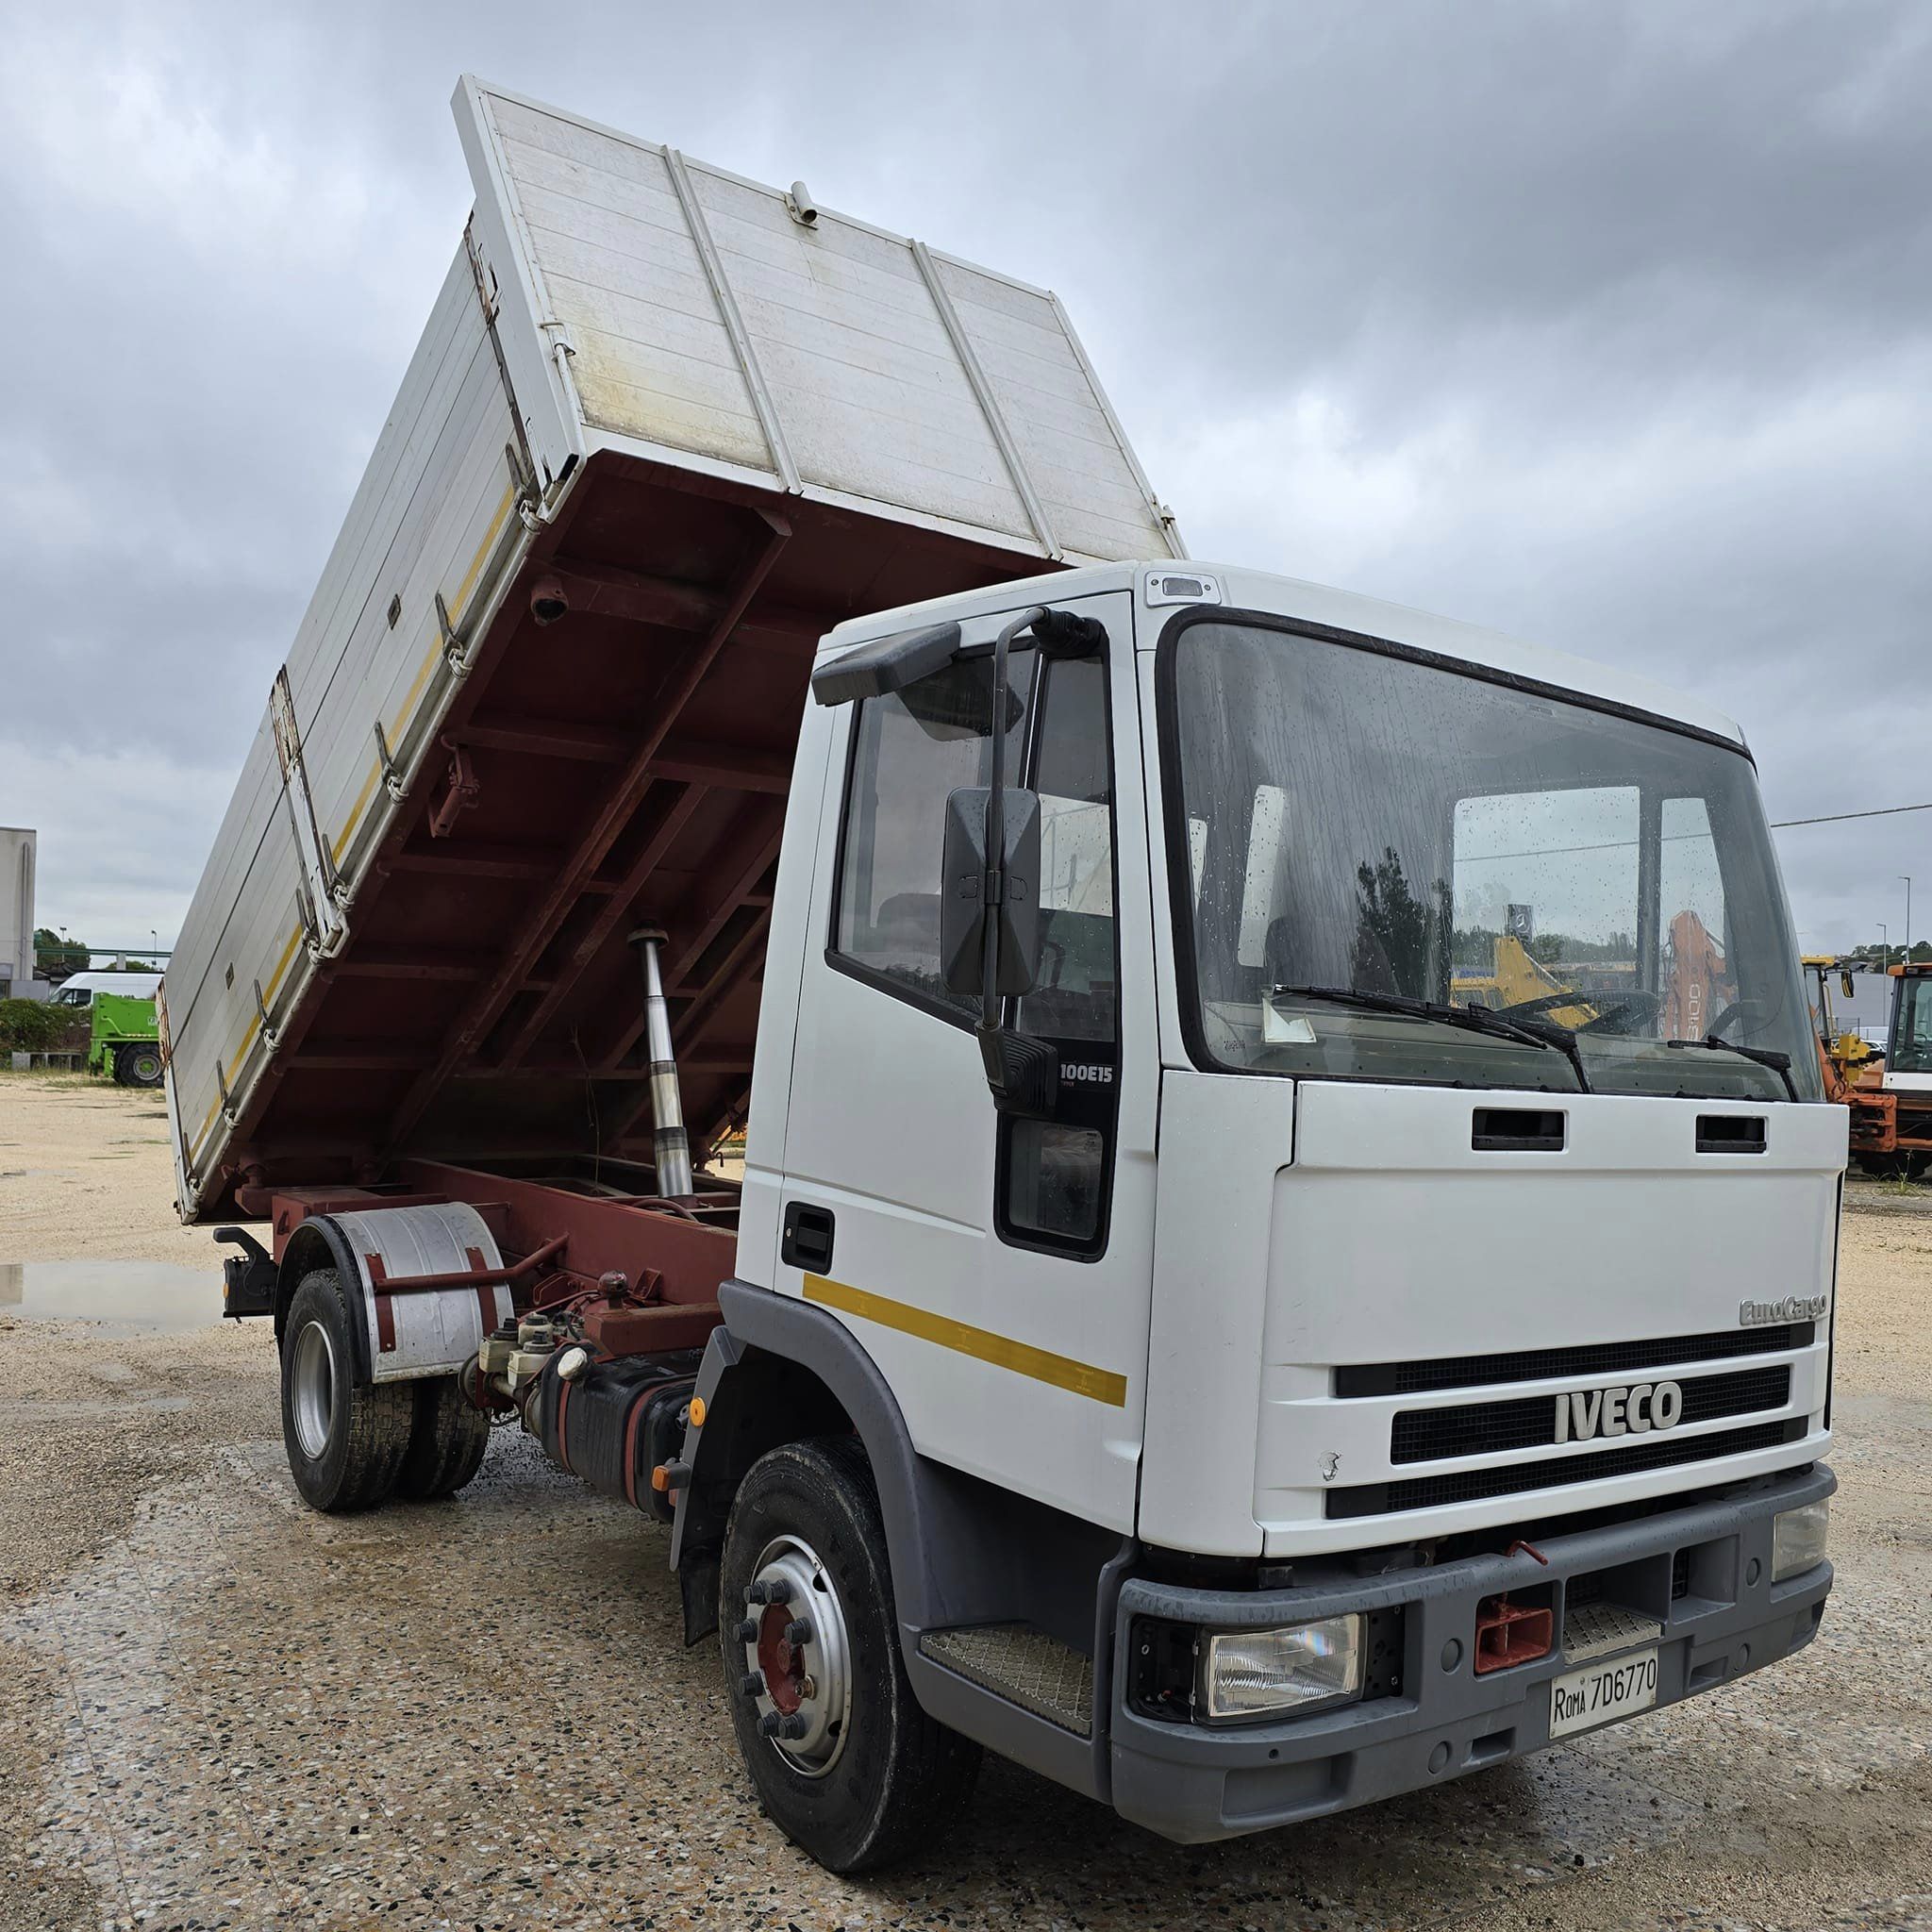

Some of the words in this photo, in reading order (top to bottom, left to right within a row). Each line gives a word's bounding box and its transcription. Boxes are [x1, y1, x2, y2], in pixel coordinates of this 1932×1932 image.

[1060, 1063, 1113, 1083] 100E15
[1740, 1294, 1826, 1325] EuroCargo
[1554, 1381, 1683, 1443] IVECO
[1591, 1658, 1657, 1710] 7D6770
